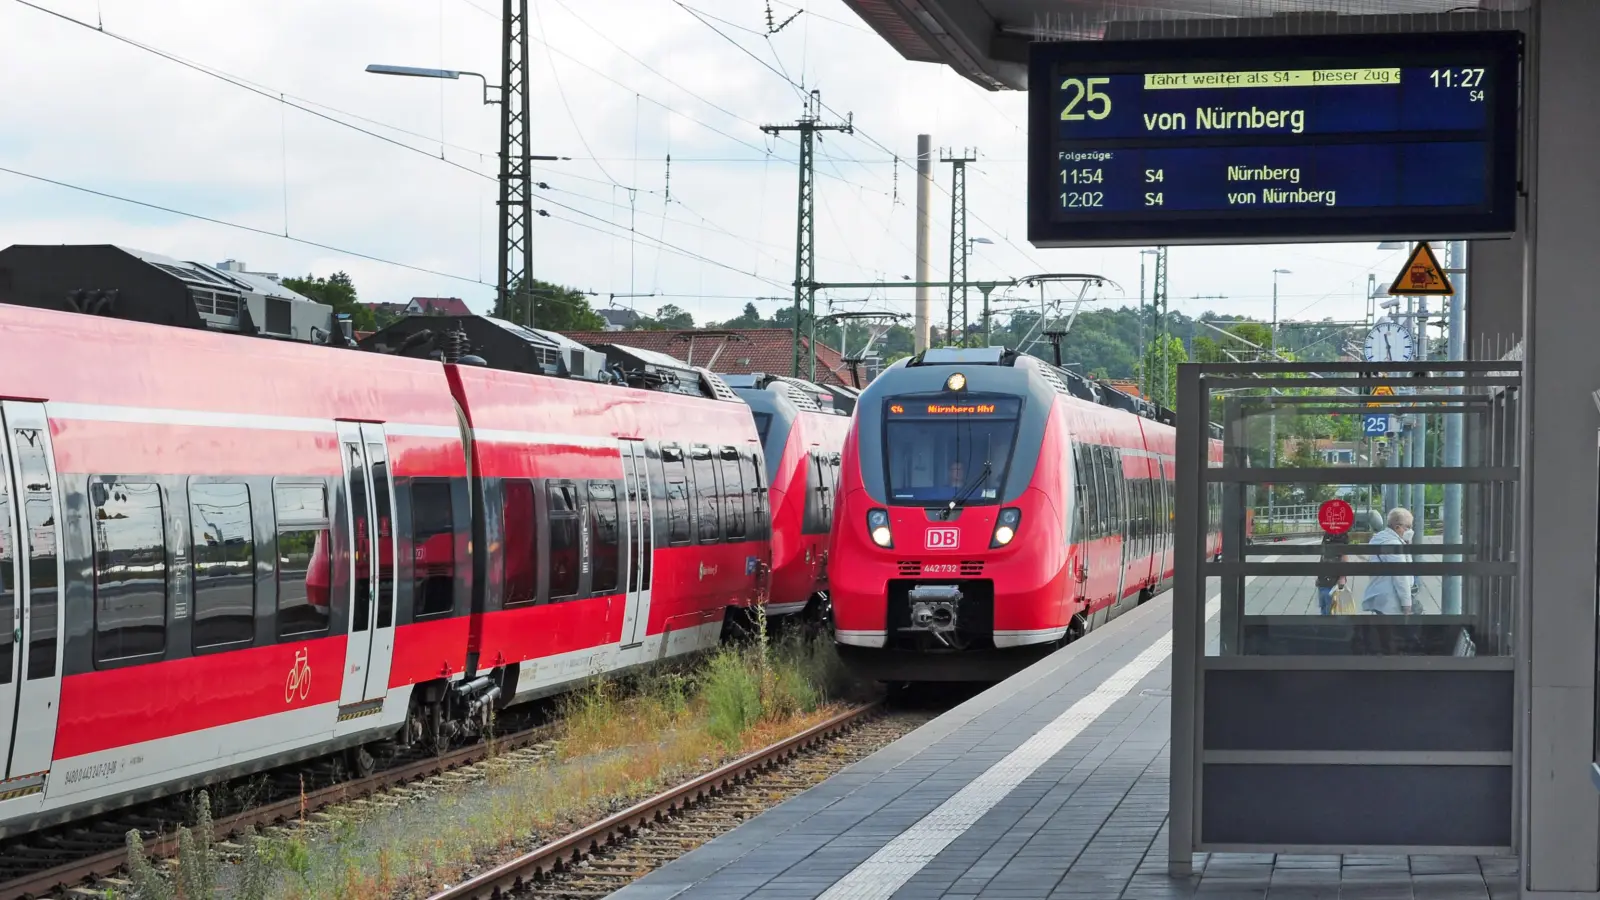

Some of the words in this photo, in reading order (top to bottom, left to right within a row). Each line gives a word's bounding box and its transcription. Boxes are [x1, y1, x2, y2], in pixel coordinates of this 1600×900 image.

[1193, 72, 1240, 85] weiter
[1247, 71, 1268, 84] als
[1273, 71, 1290, 83] S4
[1312, 70, 1358, 82] Dieser
[1364, 69, 1389, 83] Zug
[1430, 68, 1485, 88] 11:27
[1060, 77, 1112, 121] 25
[1469, 90, 1484, 102] S4
[1143, 112, 1186, 131] von
[1196, 106, 1304, 134] Nürnberg
[1058, 151, 1114, 162] Folgezüge:
[1060, 168, 1104, 184] 11:54
[1145, 168, 1164, 183] S4
[1227, 164, 1300, 184] Nürnberg
[1060, 191, 1104, 208] 12:02
[1145, 192, 1164, 206] S4
[1227, 191, 1256, 205] von
[1262, 187, 1336, 206] Nürnberg
[1367, 417, 1386, 432] 25
[175, 518, 184, 555] 2
[928, 530, 957, 547] DB
[924, 564, 940, 573] 442
[941, 564, 957, 573] 732
